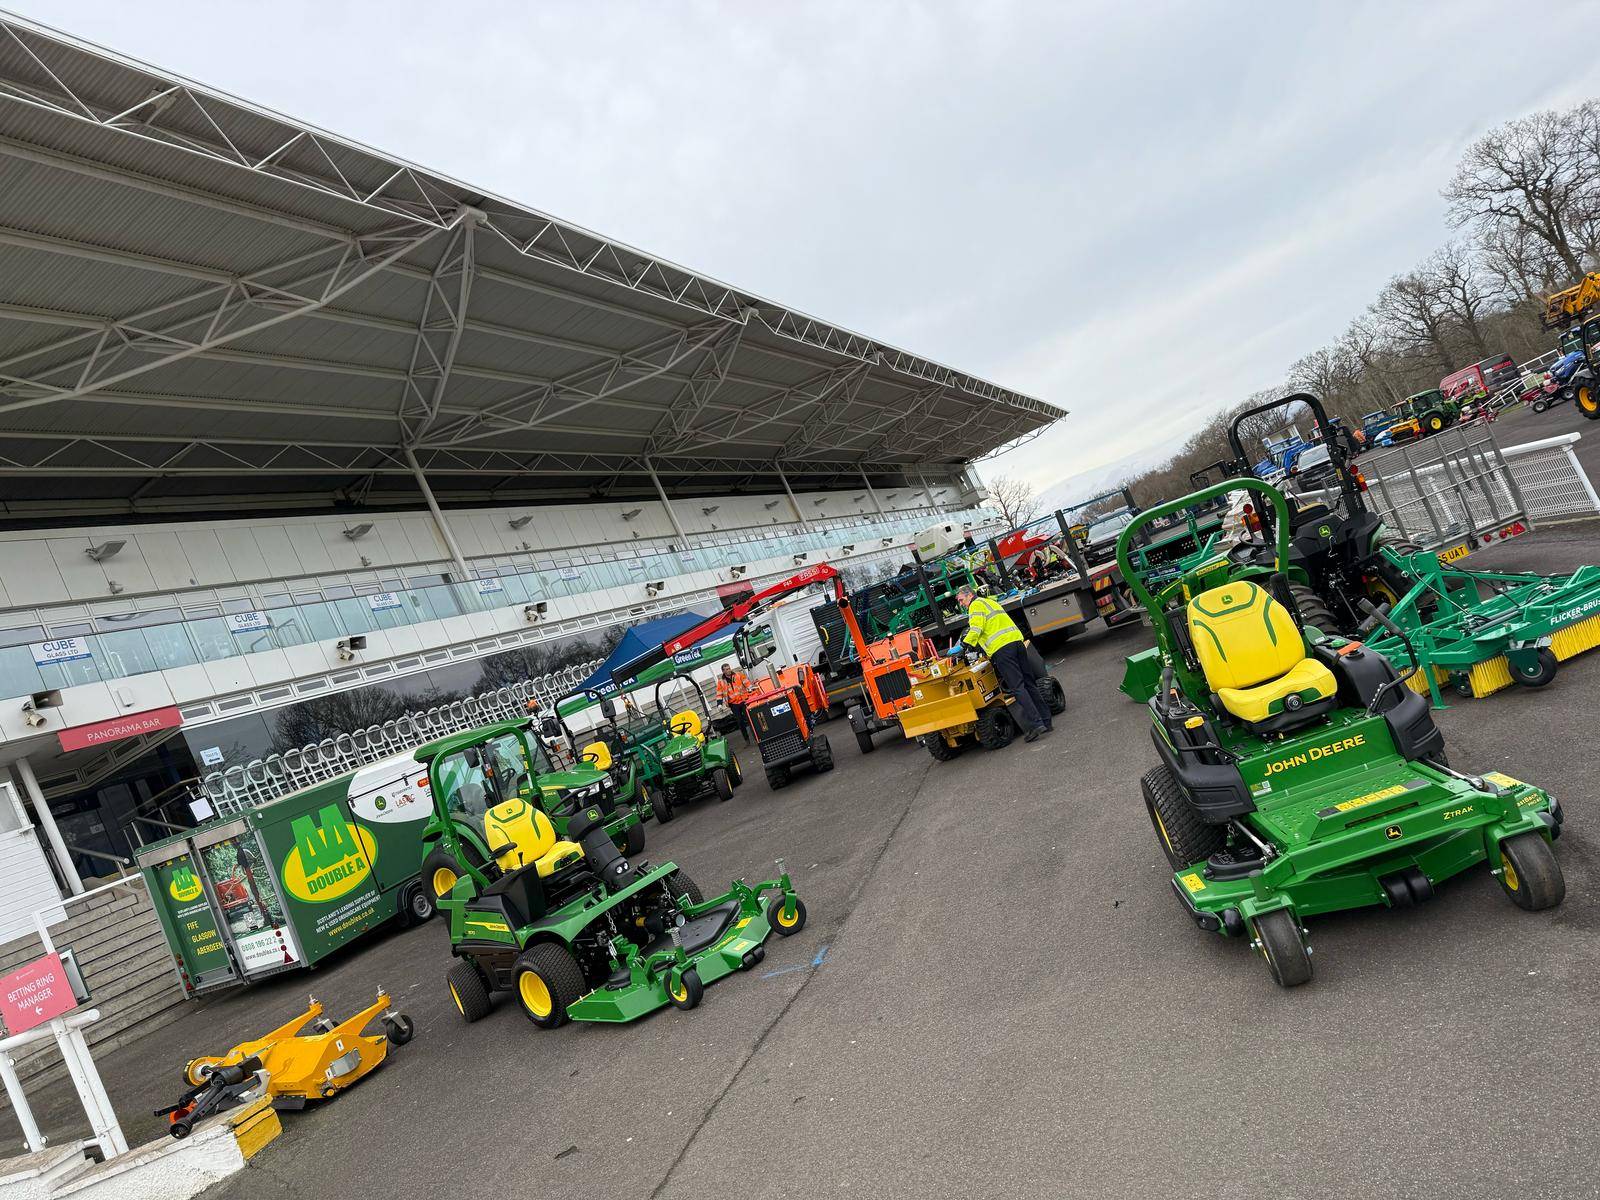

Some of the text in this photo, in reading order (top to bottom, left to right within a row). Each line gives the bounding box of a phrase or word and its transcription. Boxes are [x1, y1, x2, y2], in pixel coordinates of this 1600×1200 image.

[1448, 546, 1465, 560] UAT
[373, 593, 393, 602] CUBE
[234, 612, 258, 623] CUBE
[42, 639, 76, 652] CUBE
[46, 650, 67, 659] GLASS
[87, 723, 141, 742] PANORAMA
[143, 718, 161, 729] BAR
[1263, 734, 1366, 777] JOHN DEERE
[306, 856, 366, 895] DOUBLE A
[186, 920, 200, 931] FIFE
[328, 907, 376, 937] www.doublea.co.uk
[191, 929, 217, 943] GLASGOW
[196, 941, 224, 956] ABERDEEN
[7, 982, 37, 1003] BETTING
[35, 972, 55, 989] RING
[17, 987, 54, 1012] MANAGER
